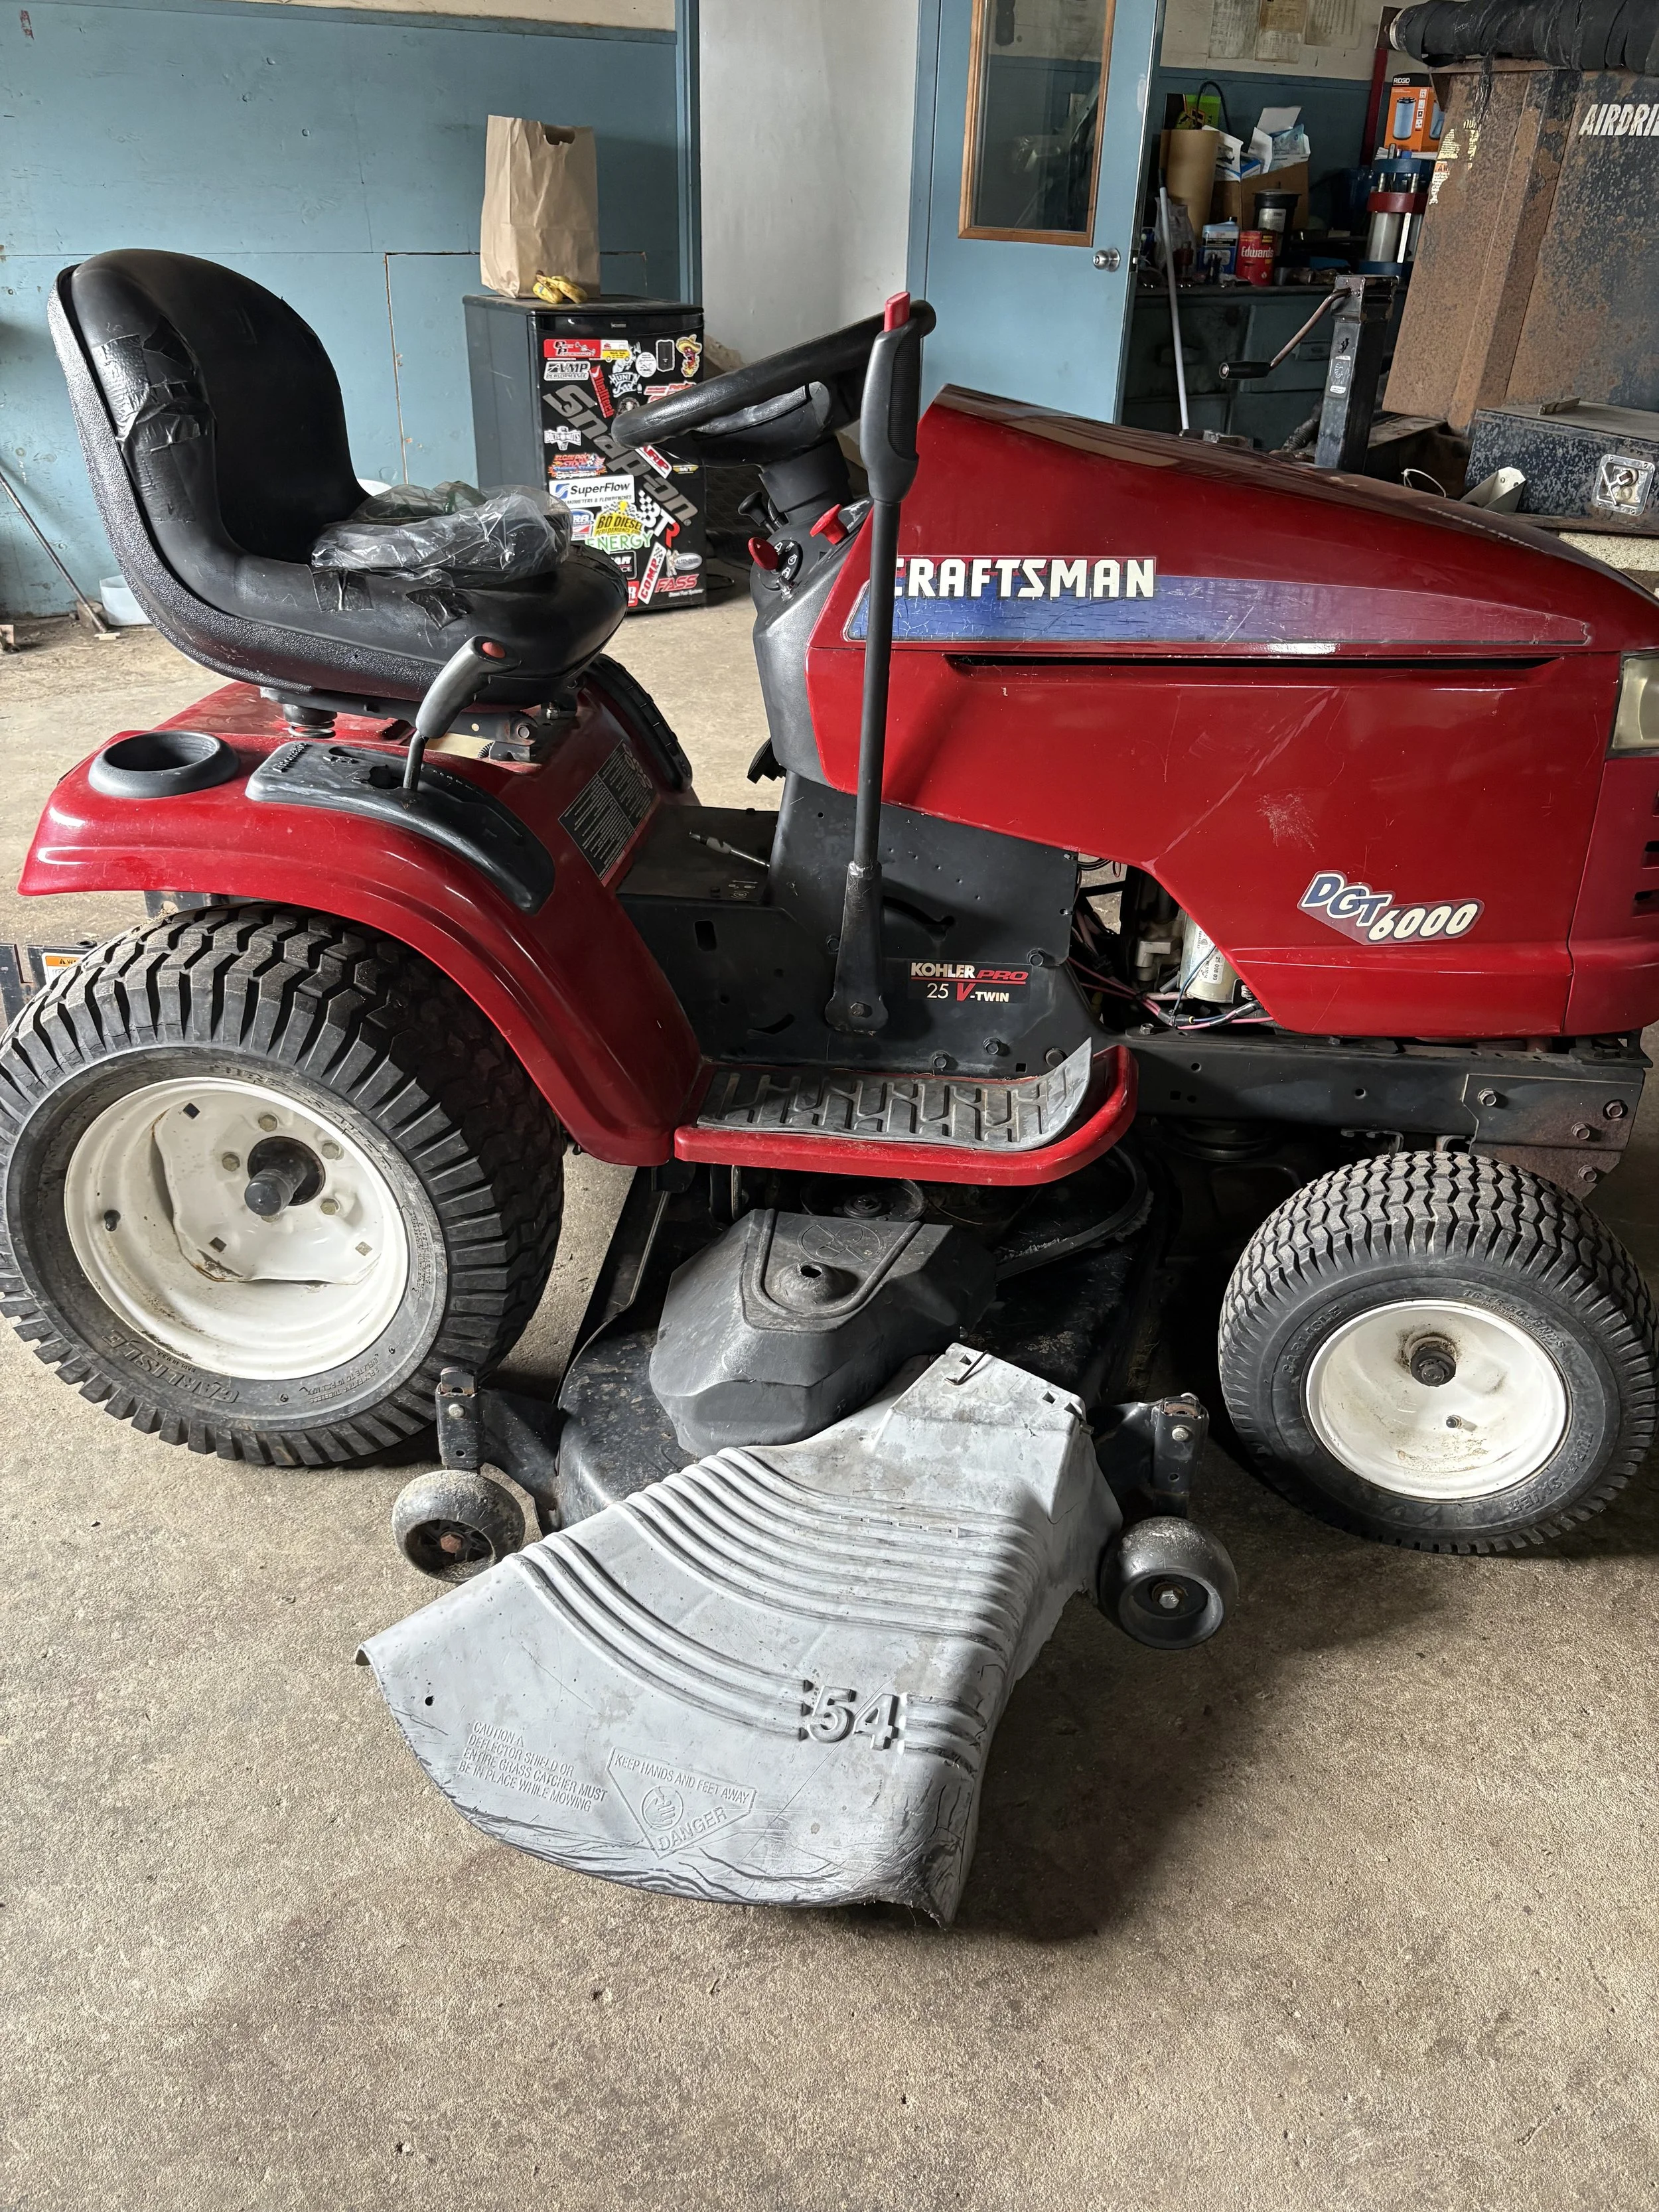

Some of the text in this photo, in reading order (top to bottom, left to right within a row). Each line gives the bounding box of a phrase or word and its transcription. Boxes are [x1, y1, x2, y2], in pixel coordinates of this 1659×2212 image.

[1241, 246, 1274, 258] Edwards
[559, 364, 588, 373] VMP
[542, 385, 698, 523] Snap-on
[571, 482, 630, 497] SuperFlow
[587, 532, 652, 550] ENERGY
[614, 516, 643, 531] DIESEL
[640, 557, 658, 599] COMP
[655, 574, 699, 593] FASS
[1301, 873, 1480, 941] DGT 6000
[911, 962, 1029, 981] KOHLER PRO
[926, 982, 1009, 1002] 25 V-TWIN
[1281, 1305, 1342, 1376] CARLISLE
[102, 1329, 240, 1404] CARLISLE
[473, 1721, 516, 1744] CAUTION
[806, 1685, 899, 1751] 54
[463, 1747, 609, 1803] ENTIRE GRASS CATCHER MUST
[467, 1733, 575, 1778] DEFLECTOR SHIELD OR
[458, 1759, 593, 1813] BE IN PLACE WHILE MOWING
[614, 1753, 750, 1805] KEEP HANDS AND FEET AWAY
[656, 1805, 728, 1852] DANGER
